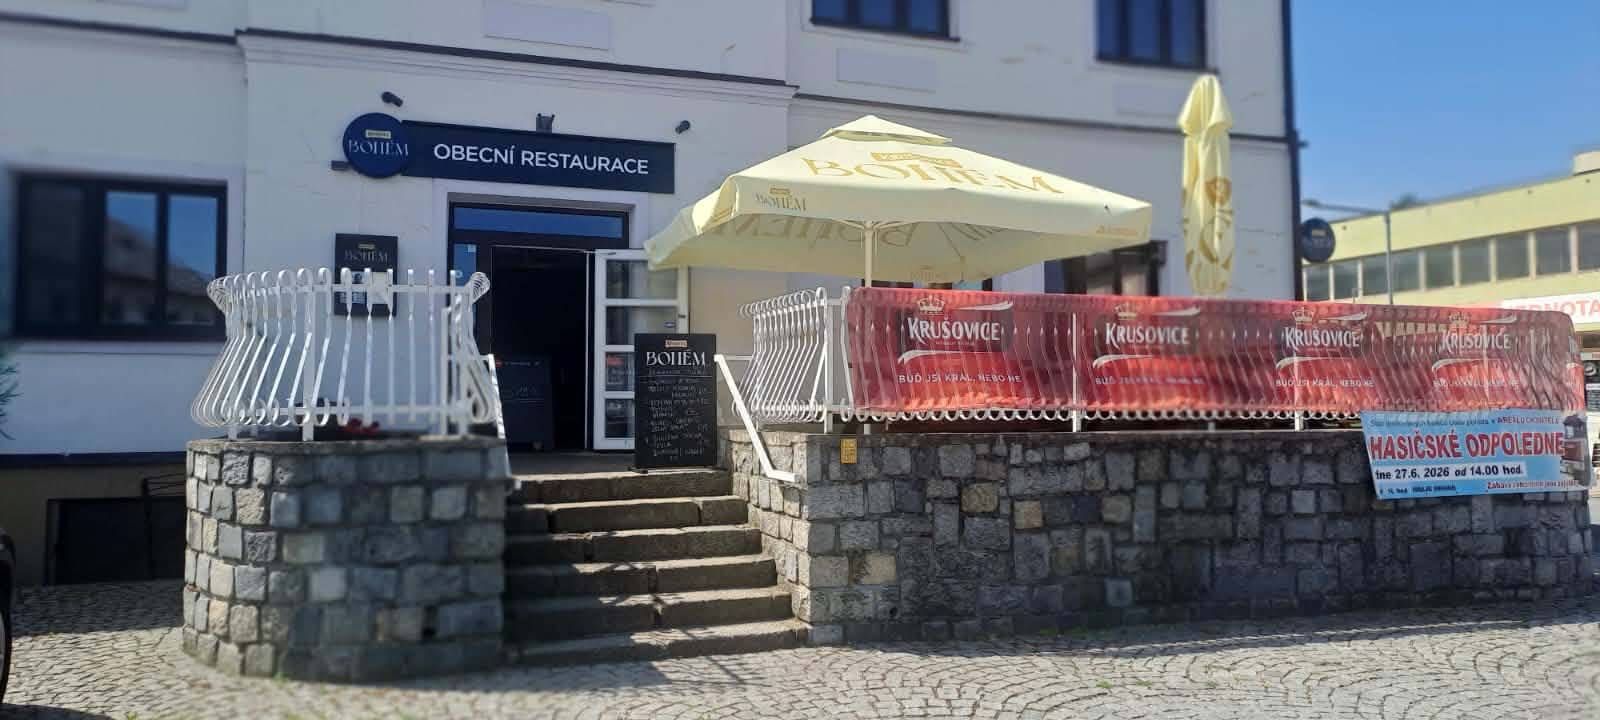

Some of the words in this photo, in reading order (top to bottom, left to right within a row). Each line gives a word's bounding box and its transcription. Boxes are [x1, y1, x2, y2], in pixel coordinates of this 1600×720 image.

[433, 143, 516, 165] OBECNÍ
[520, 149, 649, 175] RESTAURACE
[906, 316, 1001, 345] KRUŠOVICE
[645, 349, 706, 368] BOHÉM
[1370, 430, 1462, 461] HASIČSKÉ
[1465, 431, 1566, 458] ODPOLEDNE
[1394, 468, 1421, 480] 27.6.
[1423, 466, 1450, 479] 2026
[1454, 466, 1467, 477] od
[1469, 464, 1499, 477] 14.00
